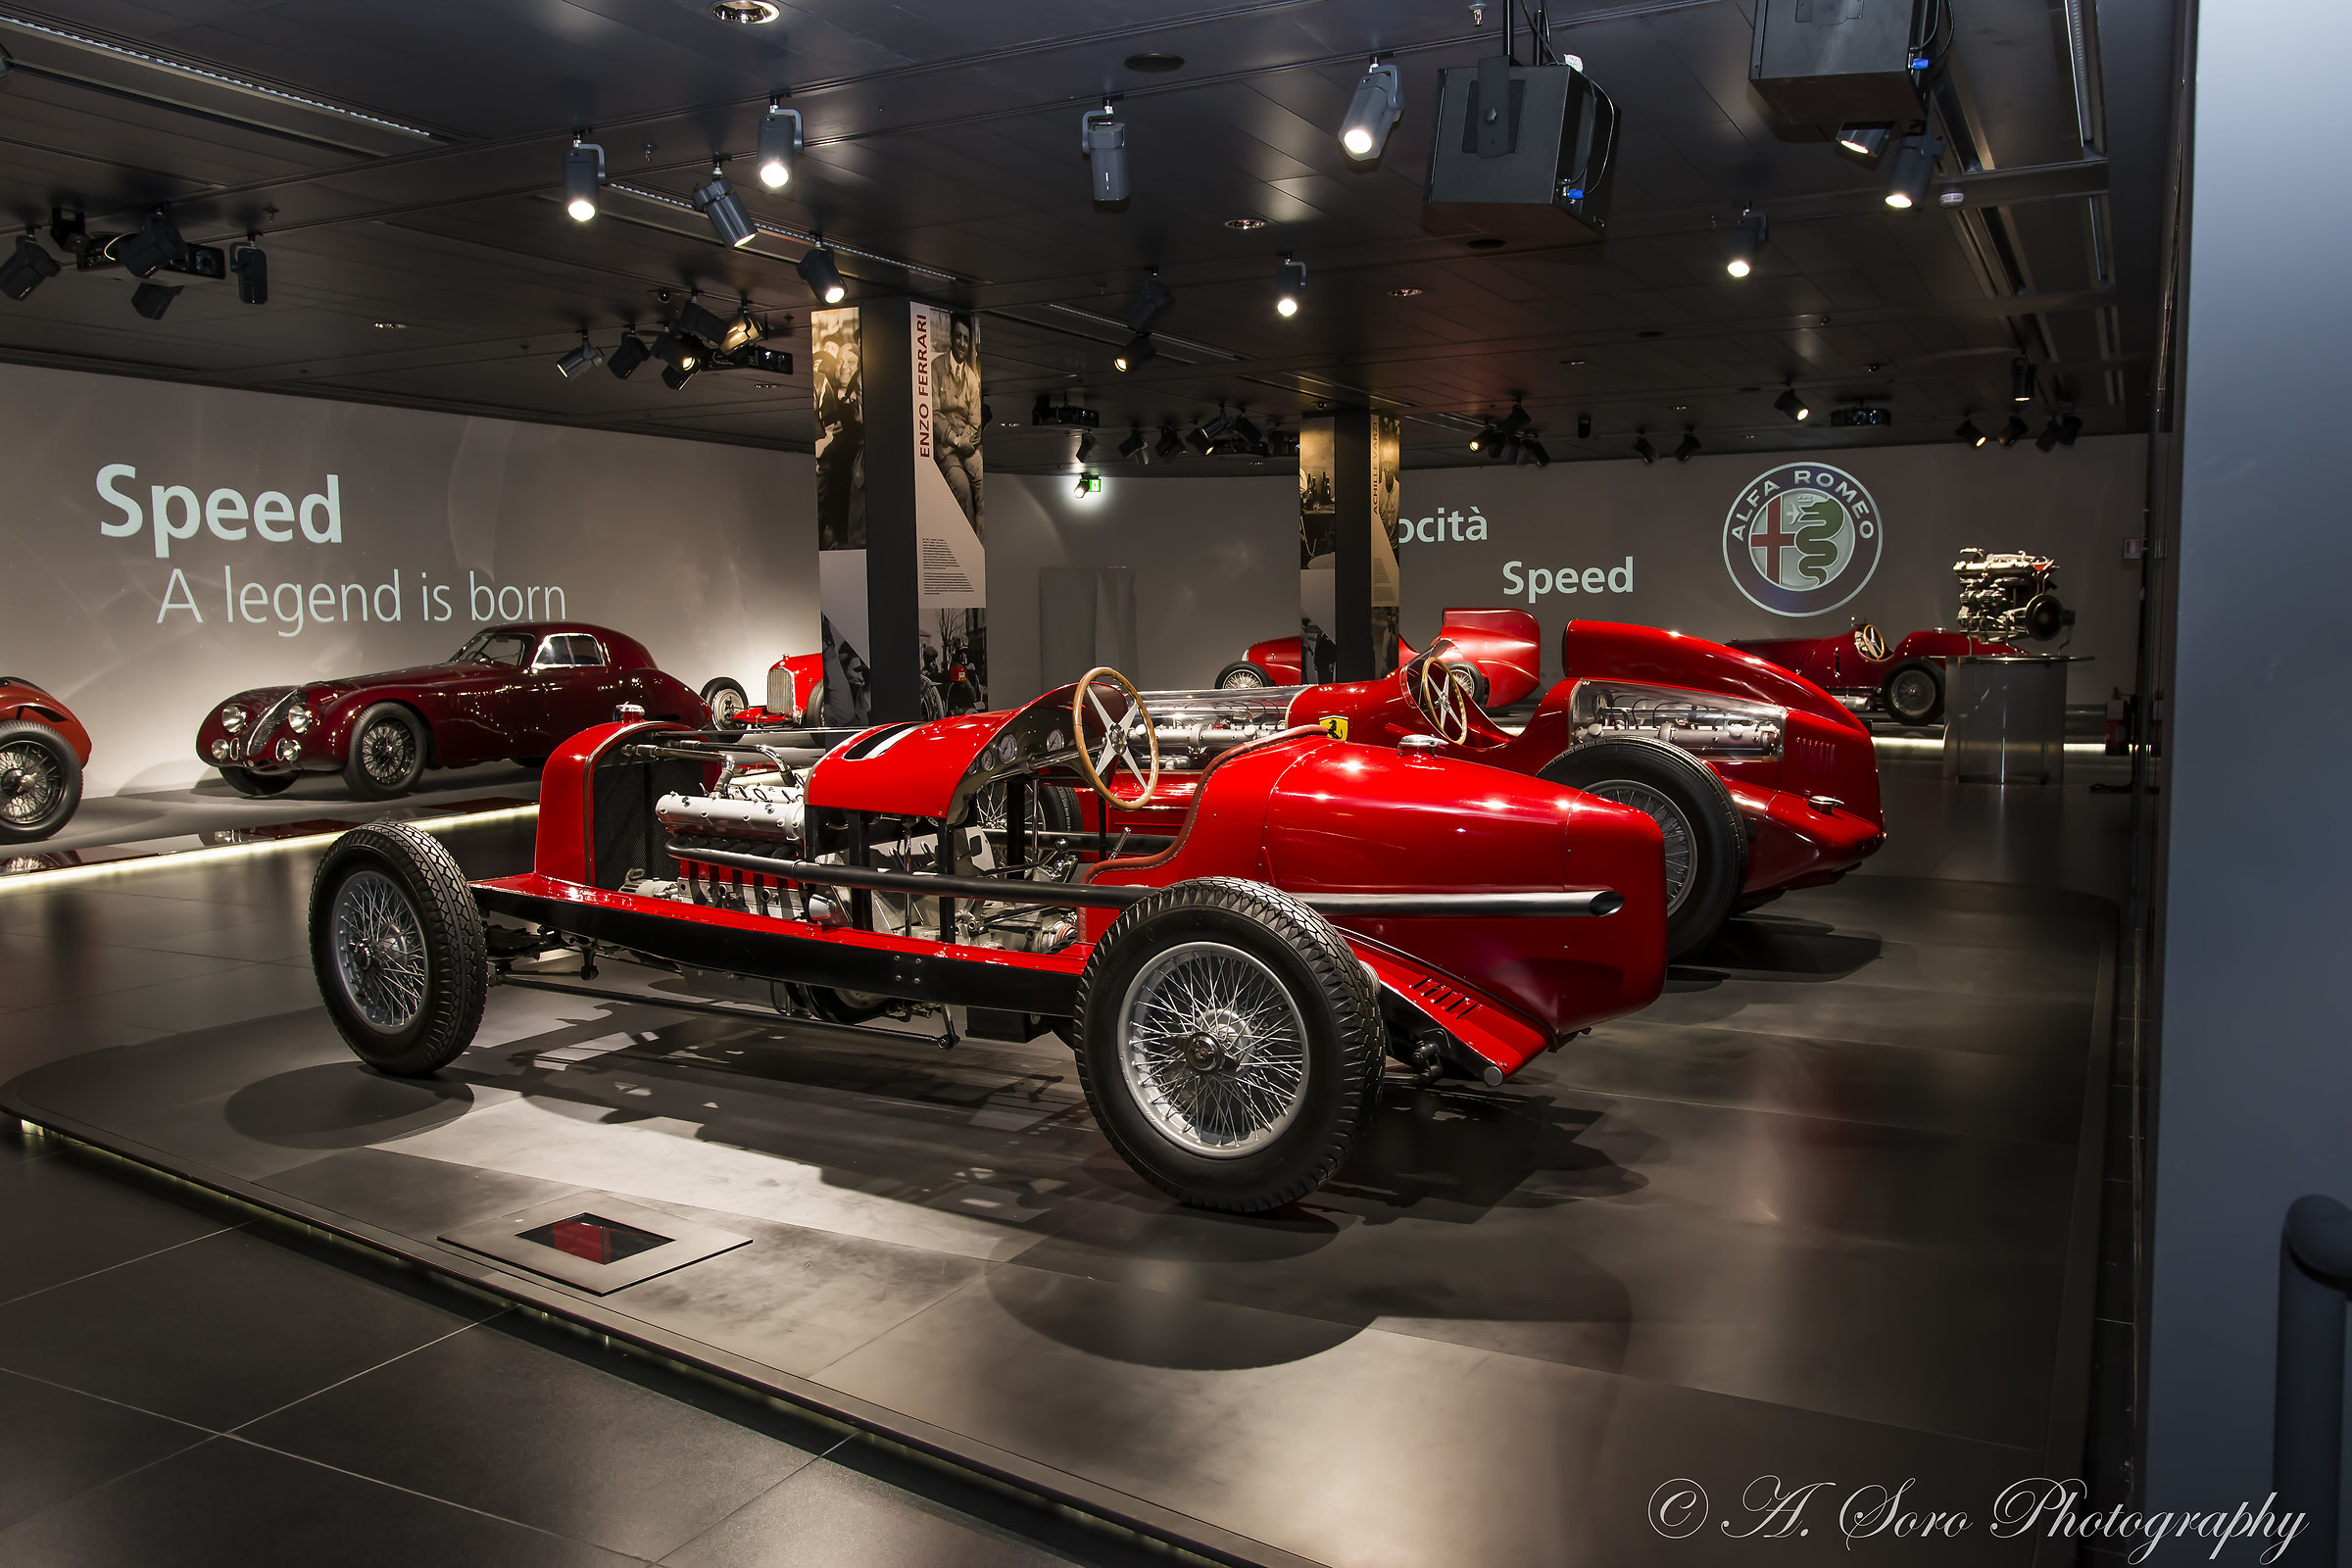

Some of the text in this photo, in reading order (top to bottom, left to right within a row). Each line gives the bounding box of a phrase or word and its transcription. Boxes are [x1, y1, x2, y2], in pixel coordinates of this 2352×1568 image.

[916, 314, 930, 458] ENZO FERRARI
[96, 464, 341, 558] Speed
[1731, 469, 1875, 541] ALFA ROMEO
[158, 565, 566, 637] A legend is born
[1503, 556, 1634, 604] Speed
